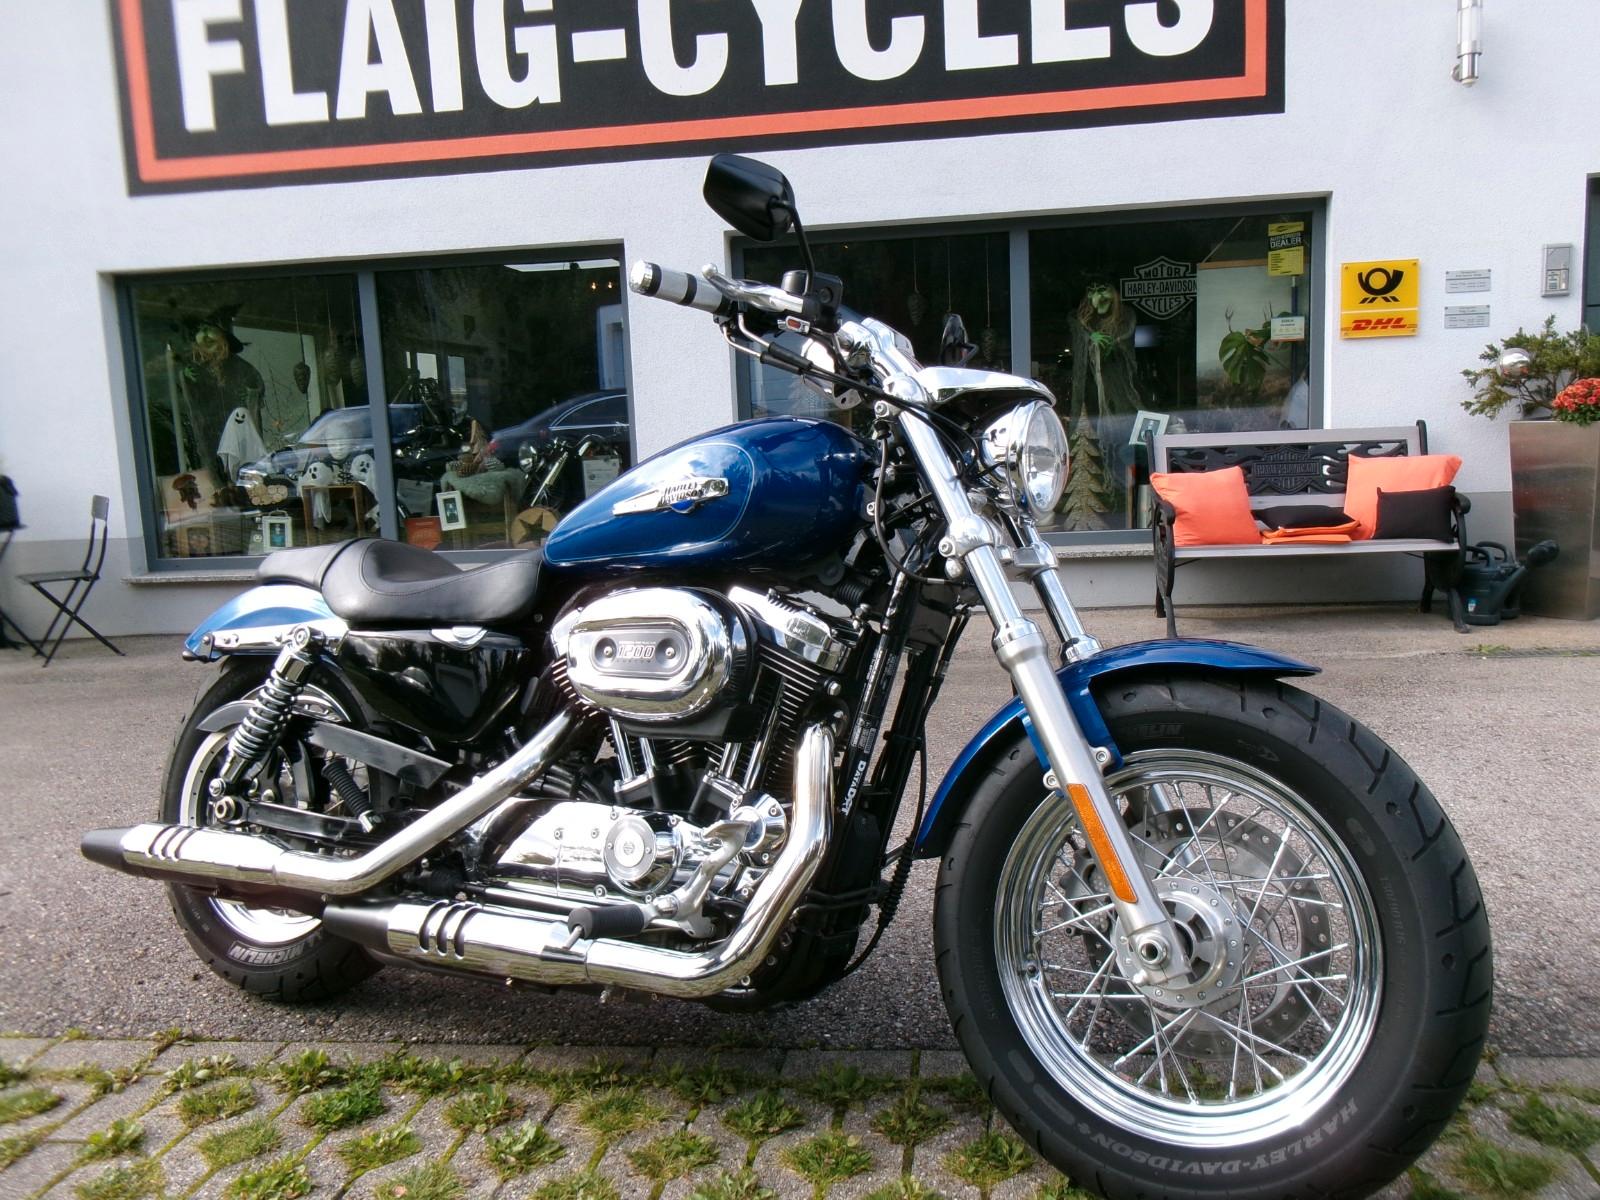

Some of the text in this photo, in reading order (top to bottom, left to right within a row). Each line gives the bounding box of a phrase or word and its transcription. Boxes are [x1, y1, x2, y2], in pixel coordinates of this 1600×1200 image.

[1270, 235, 1302, 248] DEALER
[1143, 264, 1181, 278] MOTOR
[1127, 280, 1197, 295] HARLEY-DAVIDSON
[1144, 297, 1182, 313] CYCLES
[1352, 317, 1407, 331] DHL
[664, 481, 698, 495] HARLEY
[659, 489, 704, 506] DAVIDSON
[616, 644, 655, 659] 1200
[229, 942, 305, 965] MICHELIN
